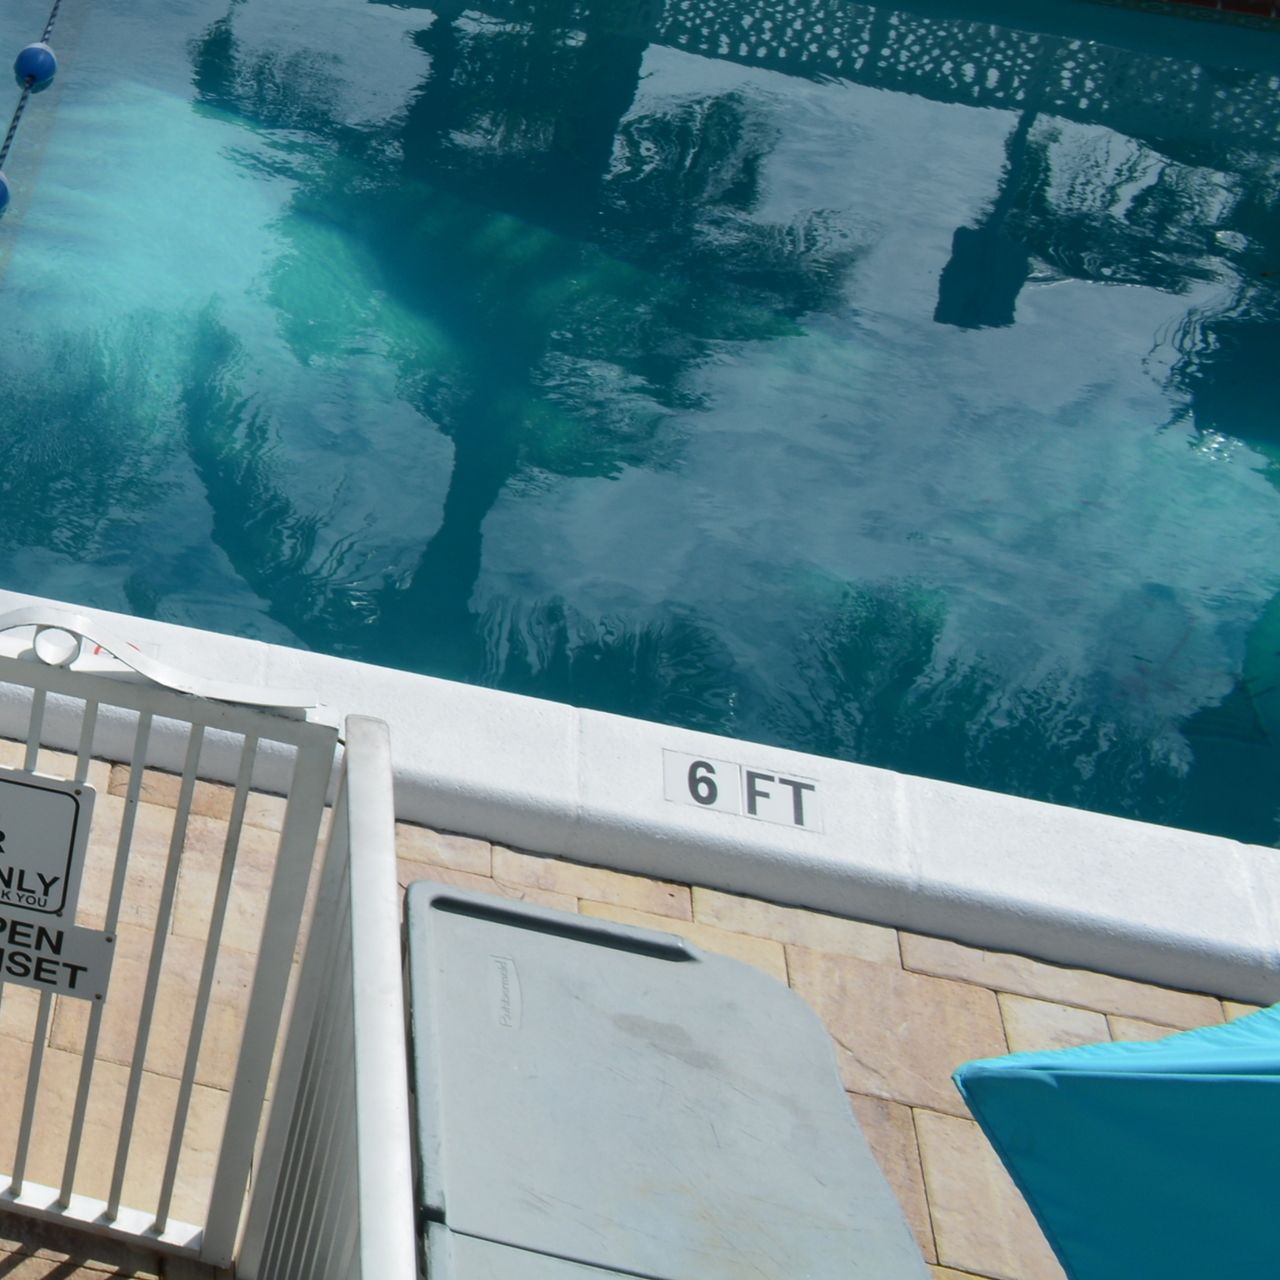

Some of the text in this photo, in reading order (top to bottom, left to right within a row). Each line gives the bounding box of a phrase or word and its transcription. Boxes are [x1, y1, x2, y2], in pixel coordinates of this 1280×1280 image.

[687, 760, 815, 826] 6 FT
[16, 892, 48, 908] YOU
